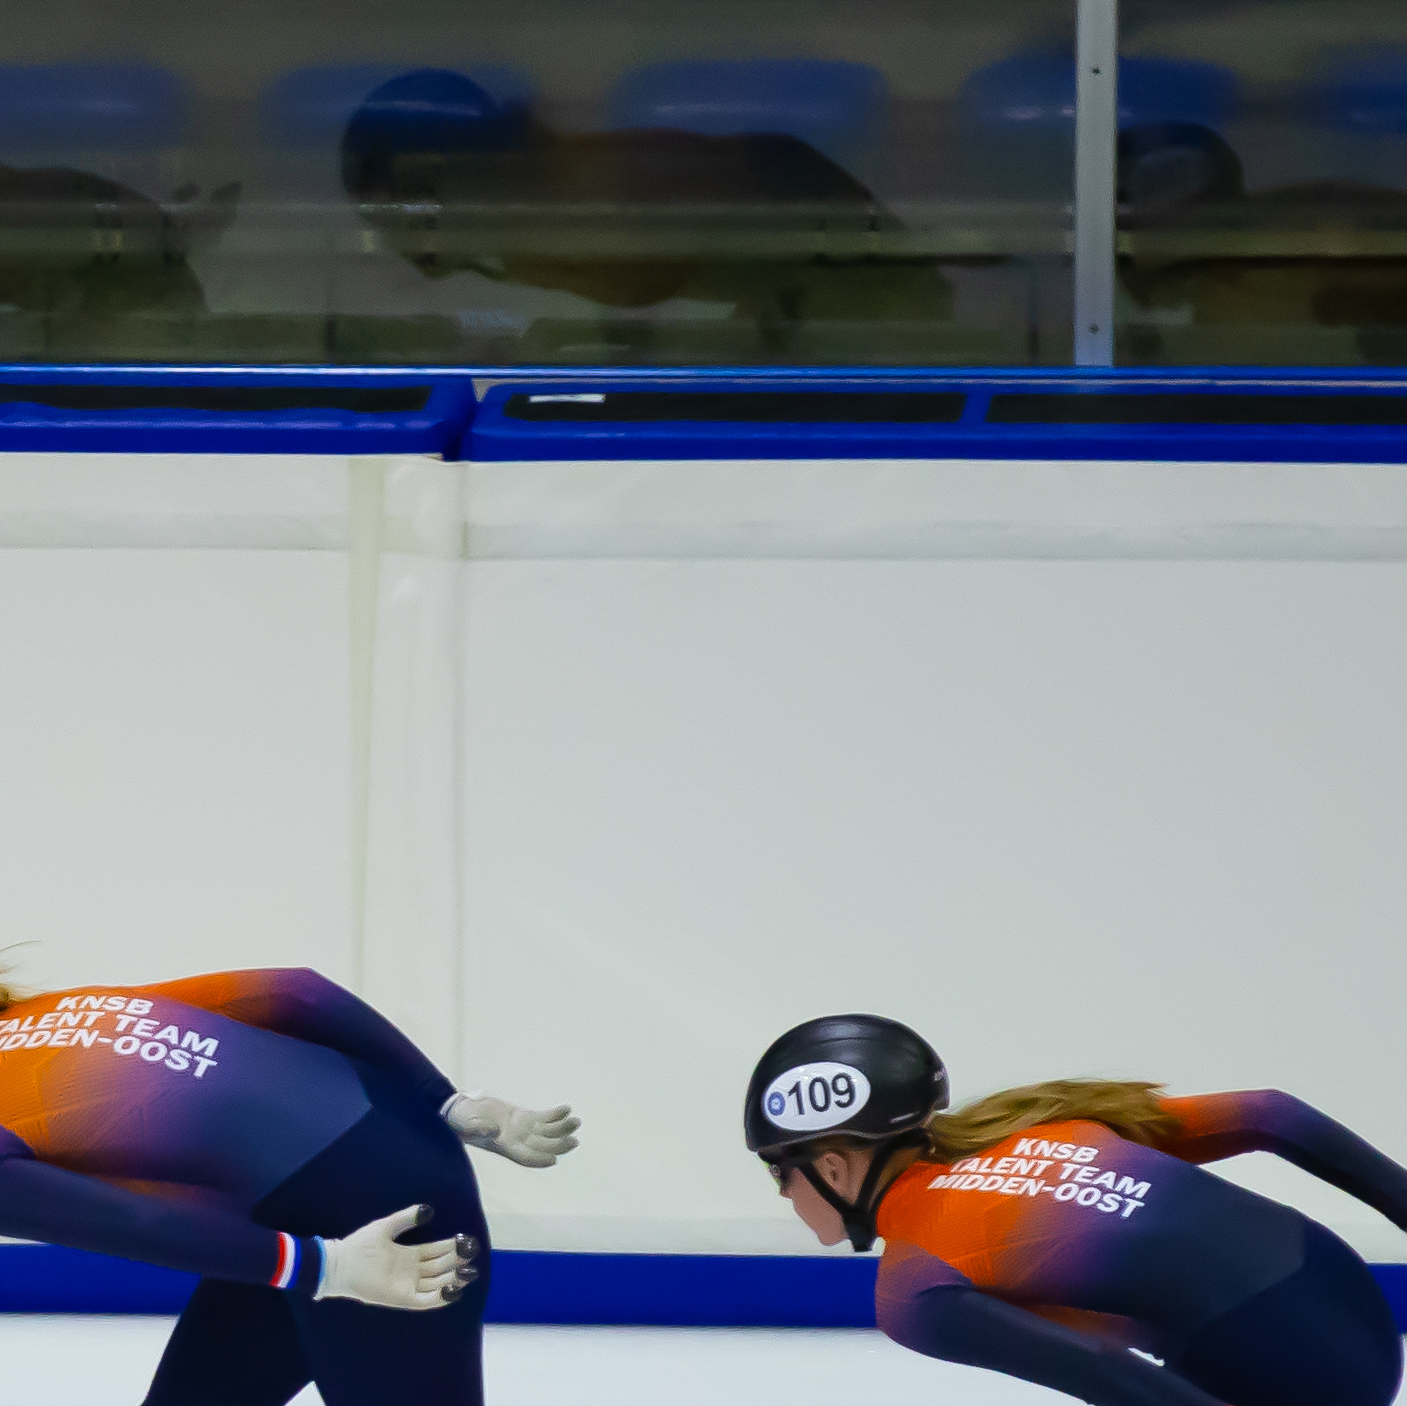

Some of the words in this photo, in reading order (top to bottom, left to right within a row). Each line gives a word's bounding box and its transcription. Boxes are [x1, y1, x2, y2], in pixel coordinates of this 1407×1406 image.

[56, 995, 154, 1015] KNSB
[115, 1014, 219, 1057] TEAM
[787, 1072, 857, 1115] 109
[1012, 1138, 1099, 1163] KNSB
[926, 1174, 1145, 1218] MIDDEN-OOST
[949, 1156, 1054, 1177] TALENT
[1059, 1162, 1151, 1199] TEAM
